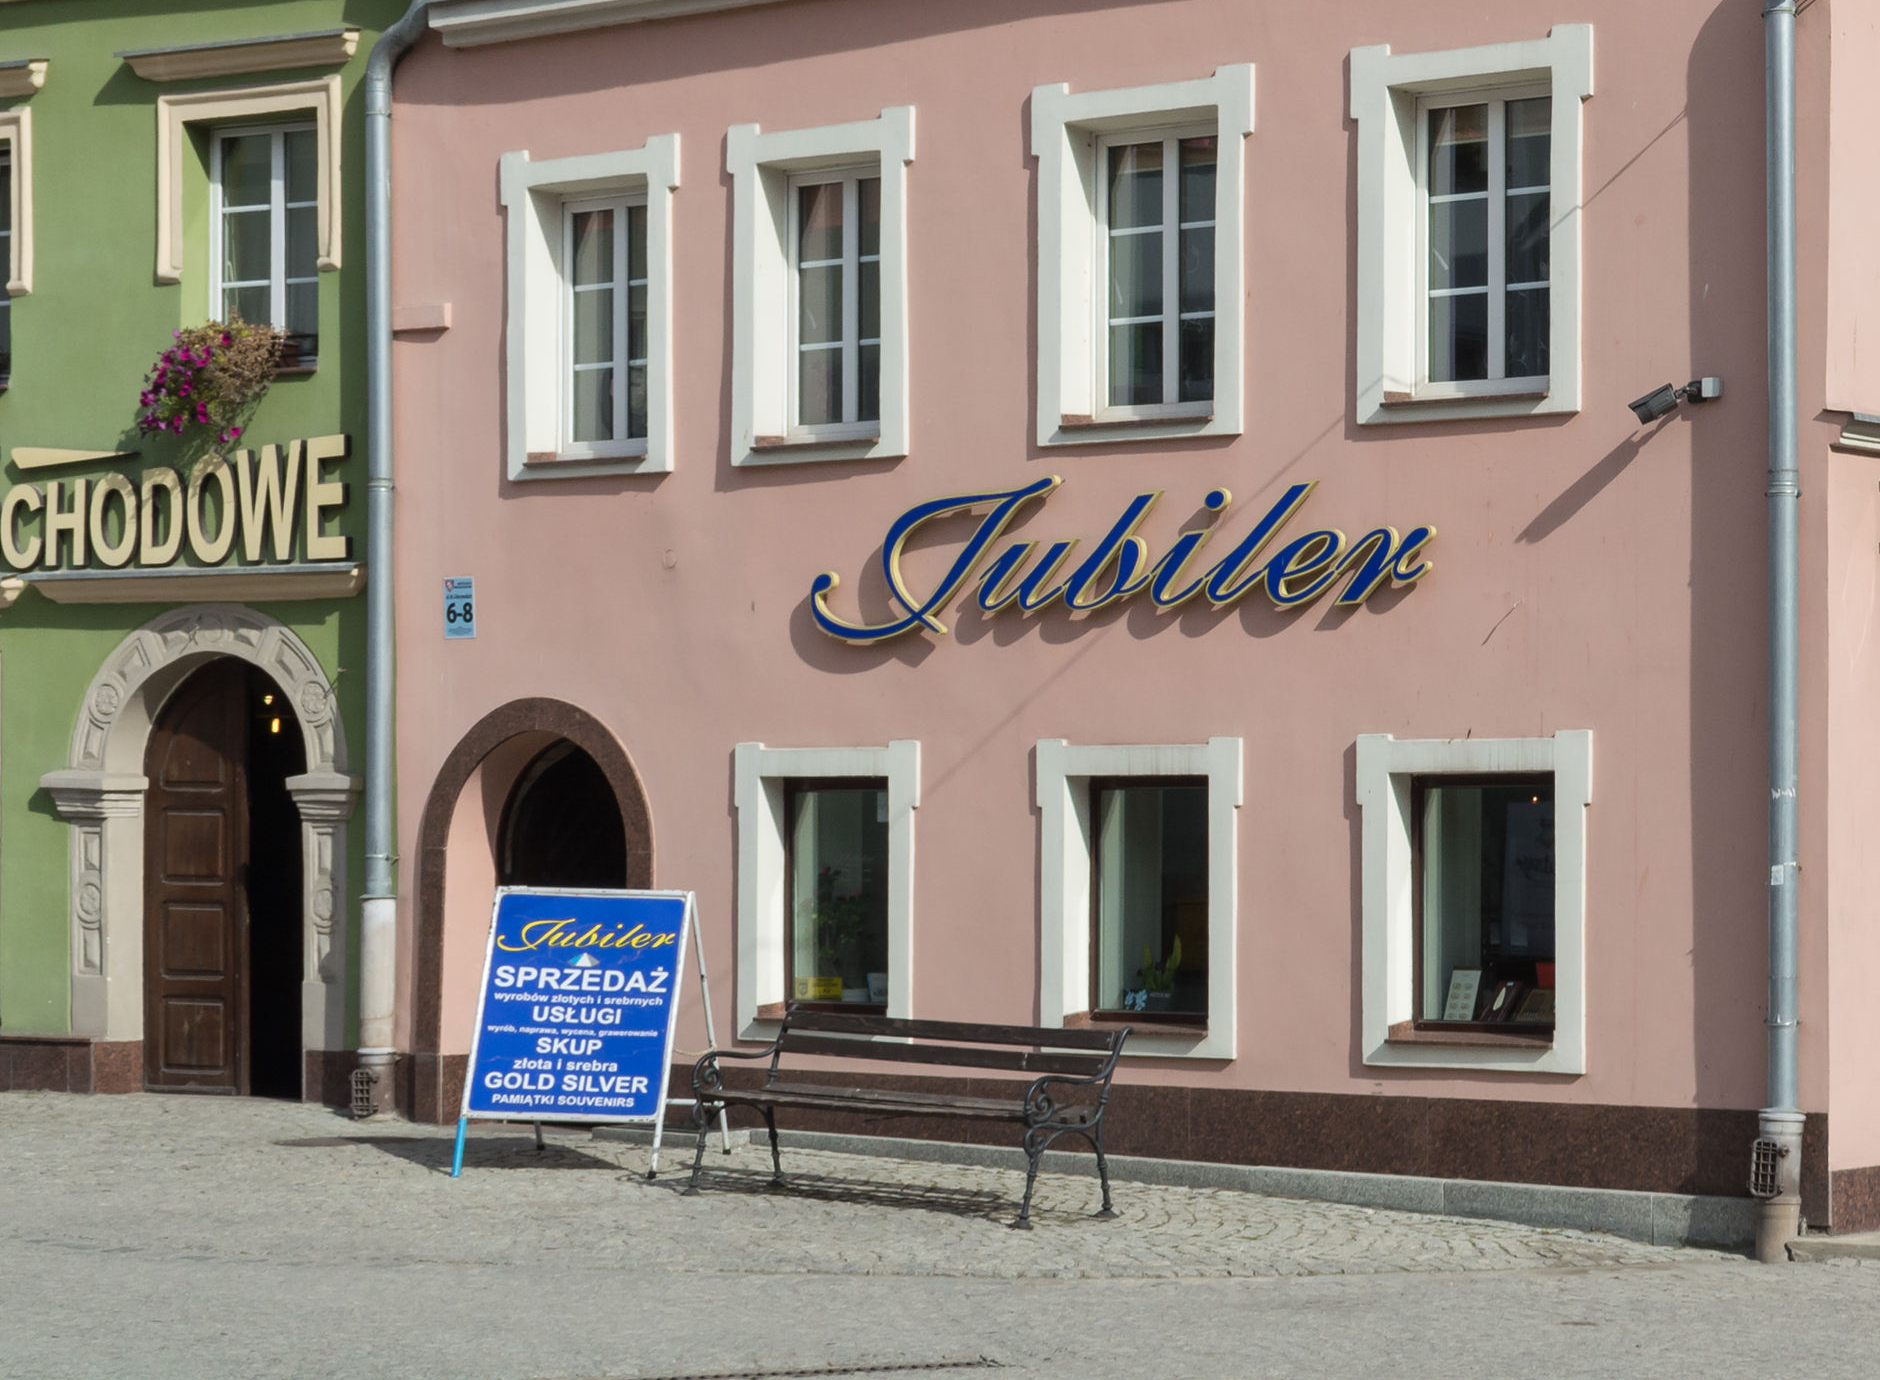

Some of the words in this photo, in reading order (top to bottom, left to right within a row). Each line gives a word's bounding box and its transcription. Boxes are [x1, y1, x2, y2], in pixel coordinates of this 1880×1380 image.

[0, 433, 350, 569] CHODOWE
[810, 474, 1437, 642] Jubiler
[447, 602, 473, 623] 6-8
[497, 918, 676, 952] Jubiler
[494, 965, 669, 993] SPRZEDAŻ
[494, 992, 549, 1003] wyrobów
[597, 995, 601, 1004] i
[604, 996, 663, 1007] srebrnych
[532, 1005, 622, 1025] USŁUGI
[487, 1024, 517, 1033] wyrób,
[519, 1026, 559, 1035] naprawa,
[561, 1028, 596, 1036] wycena,
[536, 1037, 603, 1056] SKUP
[512, 1057, 552, 1070] złota
[556, 1058, 562, 1070] i
[566, 1060, 618, 1072] srebra
[484, 1071, 555, 1090] GOLD
[561, 1074, 649, 1094] SILVER
[491, 1093, 555, 1107] PAMIĄTKI
[557, 1095, 635, 1108] SOUVENIRS
